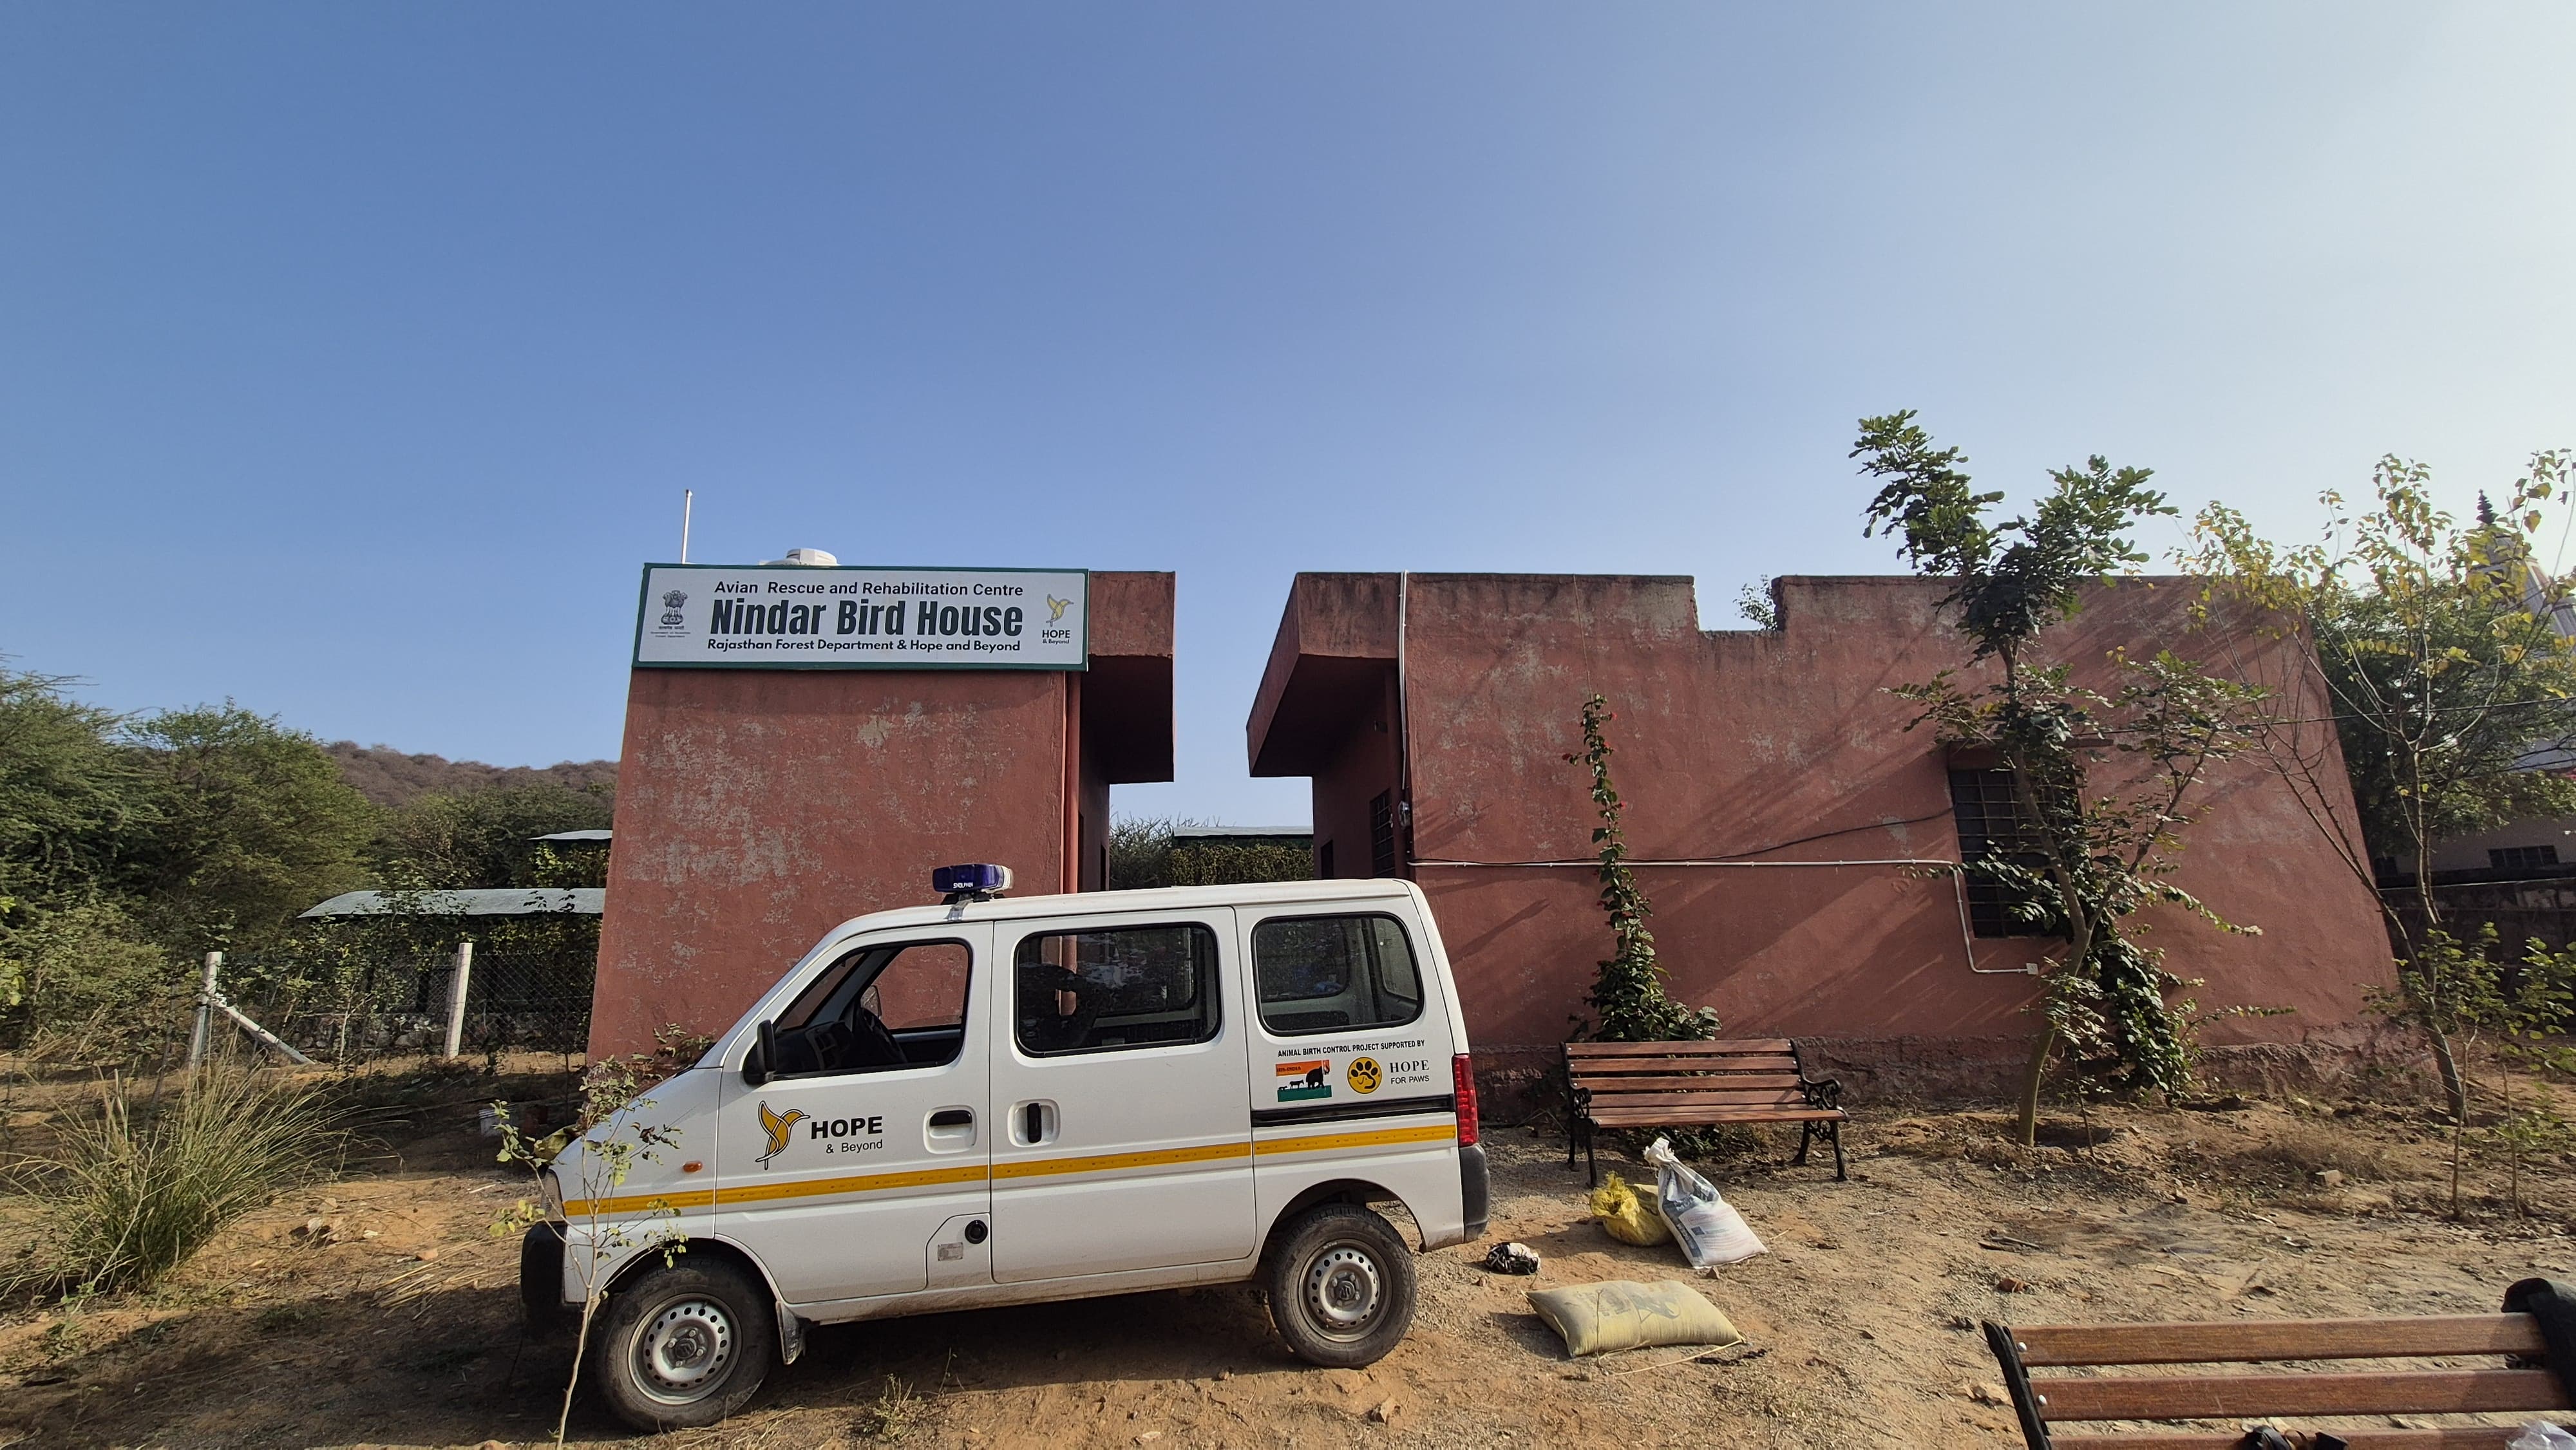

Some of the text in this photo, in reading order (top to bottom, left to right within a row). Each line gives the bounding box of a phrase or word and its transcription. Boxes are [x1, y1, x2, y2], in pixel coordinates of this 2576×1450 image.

[714, 581, 1023, 596] Avian Rescue and Rehabilitation Centre
[710, 598, 1023, 637] Nindar Bird House
[1042, 629, 1070, 639] HOPE
[707, 638, 1020, 654] Rajasthan Forest Department & Hope and Beyond
[1278, 1049, 1302, 1057] ANIMAL
[1302, 1047, 1321, 1055] BIRTH
[1322, 1045, 1351, 1054] CONTROL
[1352, 1043, 1379, 1051] PROJECT
[1380, 1040, 1416, 1050] SUPPORTED
[1390, 1060, 1430, 1073] HOPE
[1390, 1075, 1430, 1085] FOR PAWS
[811, 1116, 883, 1140] HOPE
[826, 1138, 883, 1154] & Beyond
